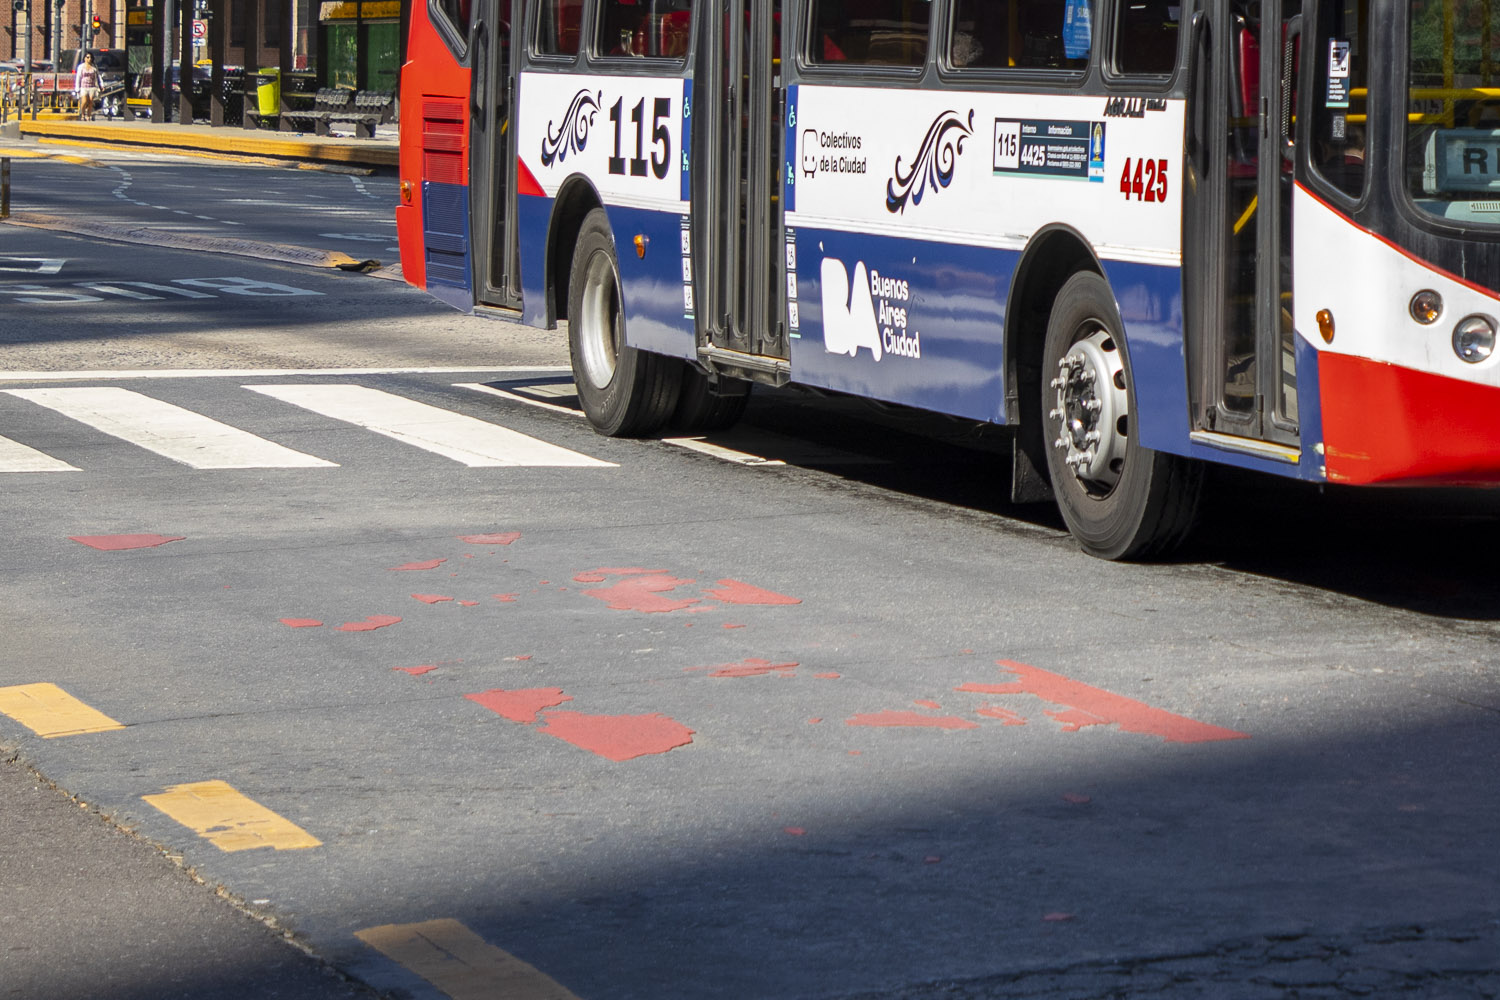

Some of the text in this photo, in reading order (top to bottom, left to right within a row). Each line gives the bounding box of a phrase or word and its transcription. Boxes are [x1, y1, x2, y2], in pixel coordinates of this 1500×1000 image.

[608, 95, 672, 180] 115
[821, 131, 862, 149] Colectivos
[998, 133, 1046, 167] 115 4425
[820, 155, 867, 174] de la Ciudad
[1120, 157, 1168, 203] 4425
[871, 270, 909, 300] Buenos
[879, 299, 907, 328] Aires
[883, 327, 921, 358] Ciudad
